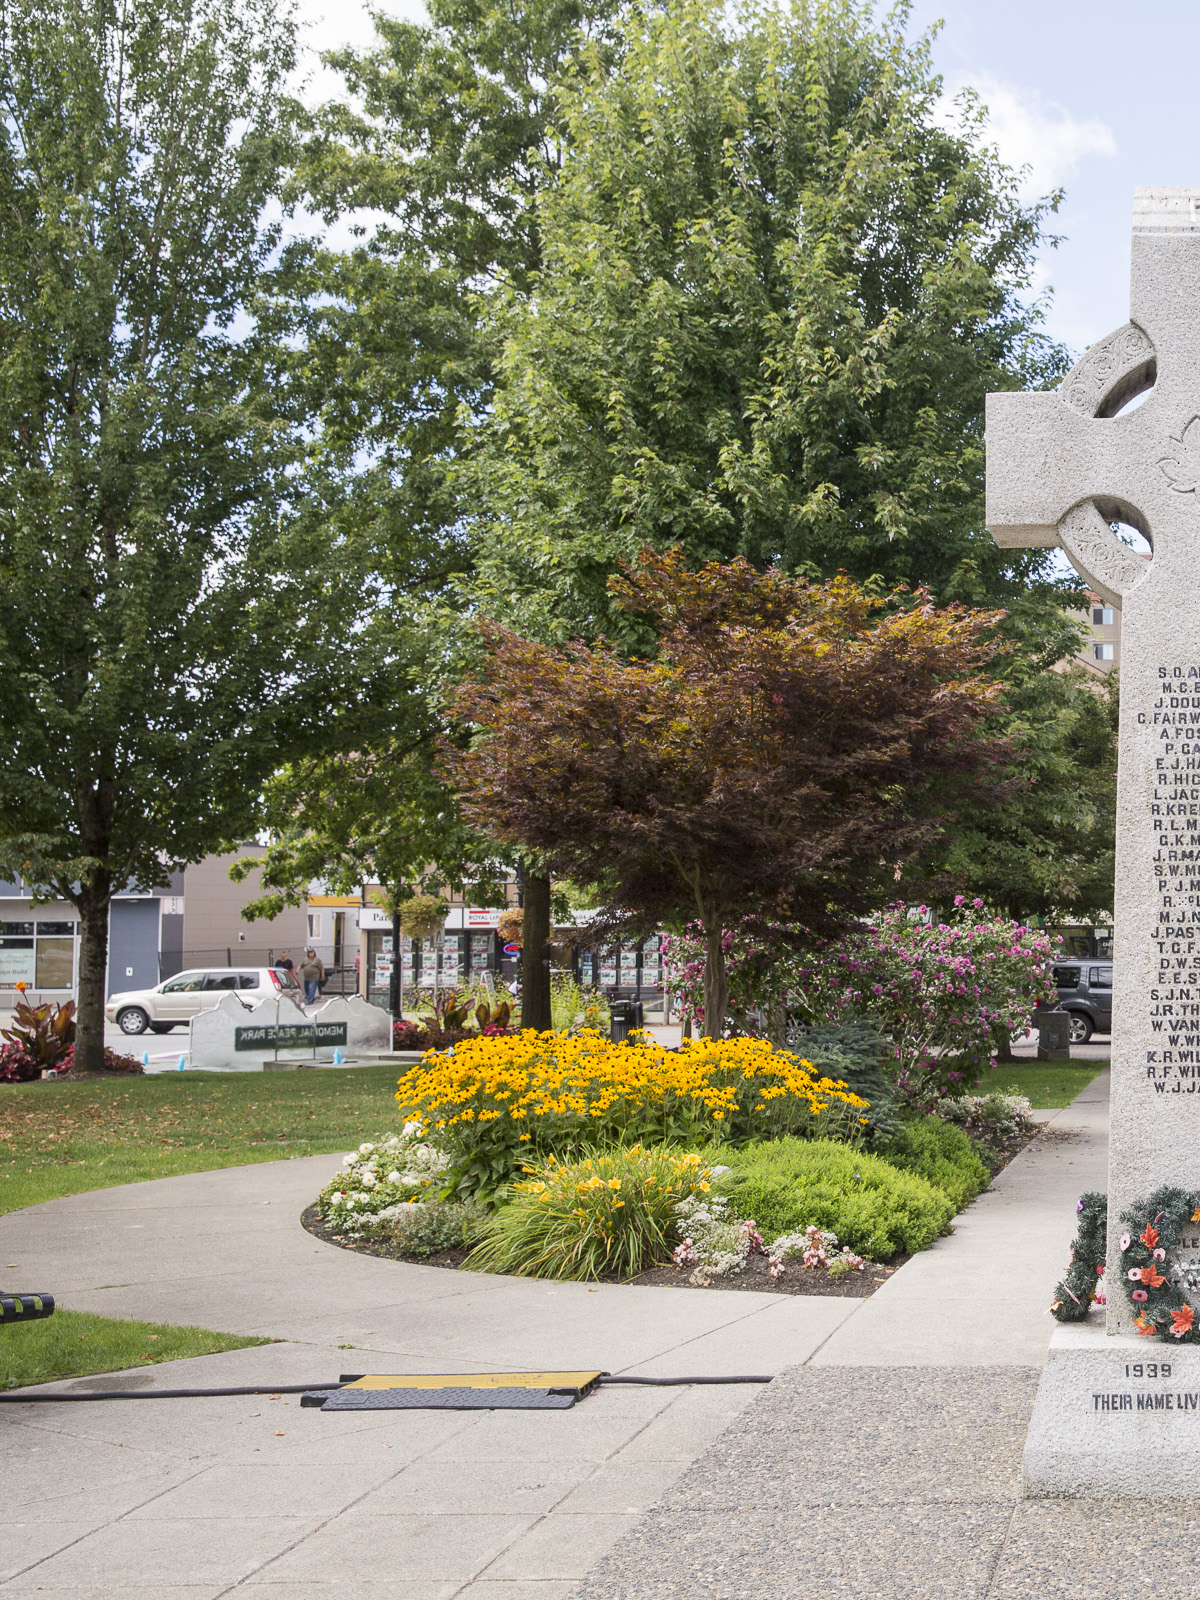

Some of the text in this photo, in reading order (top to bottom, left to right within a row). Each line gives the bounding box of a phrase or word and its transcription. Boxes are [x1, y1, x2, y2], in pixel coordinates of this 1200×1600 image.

[1125, 1363, 1172, 1378] 1939
[1092, 1394, 1133, 1410] THEIR
[1136, 1393, 1174, 1409] NAME
